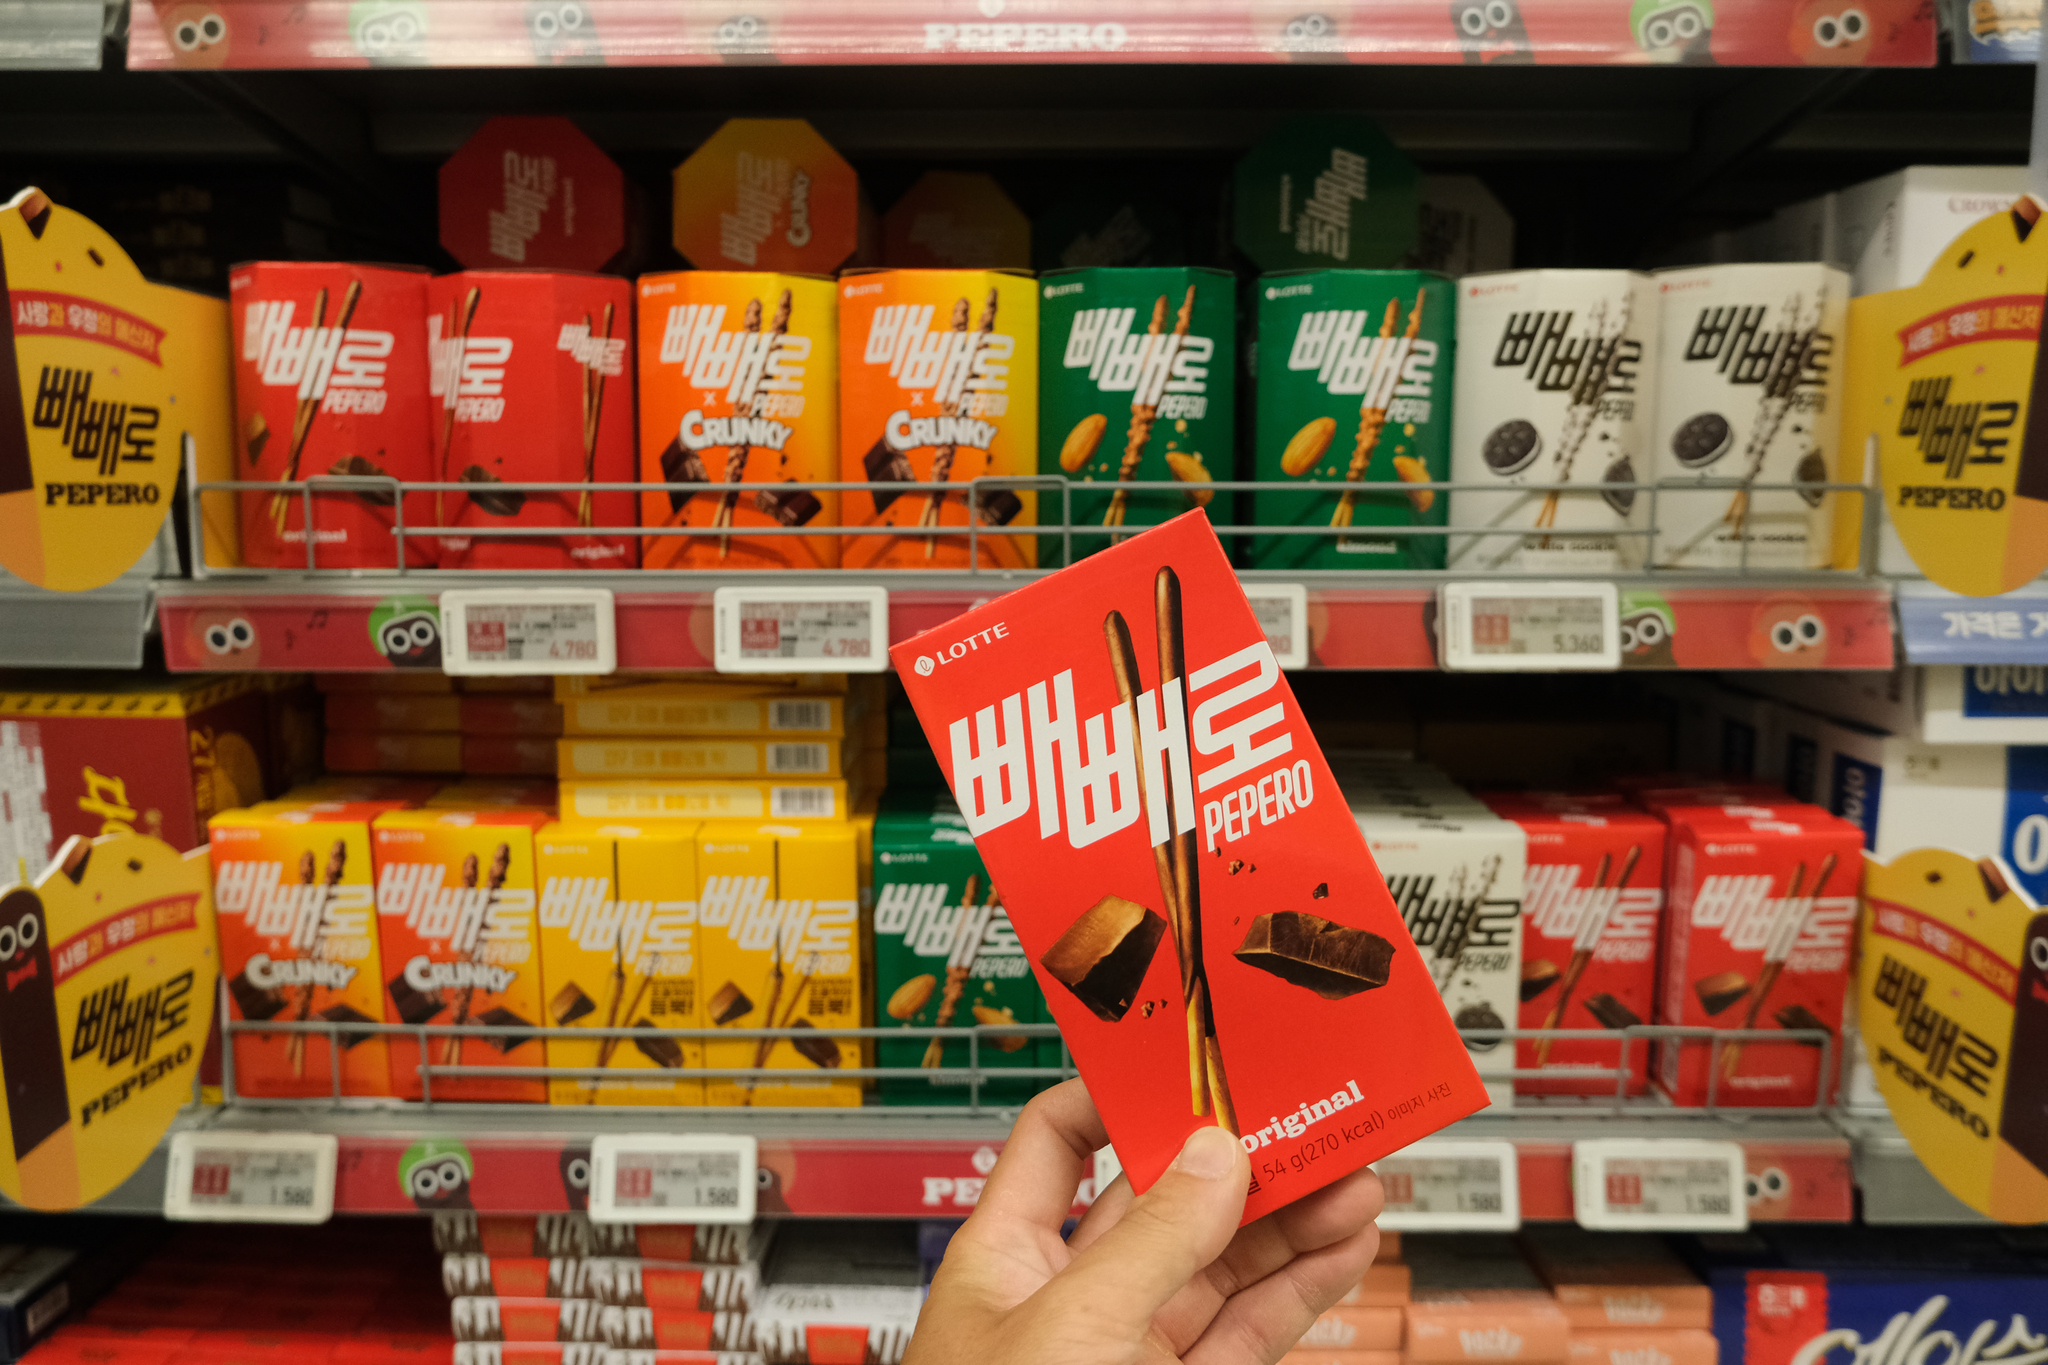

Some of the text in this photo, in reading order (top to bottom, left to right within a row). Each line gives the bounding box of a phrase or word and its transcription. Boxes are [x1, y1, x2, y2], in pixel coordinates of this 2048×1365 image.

[924, 22, 1128, 51] PEPERO
[243, 301, 395, 400] 빼빼로
[660, 304, 811, 402] 빼빼로
[864, 304, 1015, 403] 빼빼로
[1063, 307, 1214, 405] 빼빼로
[1288, 309, 1438, 410] 빼빼로
[1493, 311, 1642, 406] 빼빼로
[1684, 304, 1834, 398] 빼빼로
[33, 365, 161, 476] 빼빼로
[679, 410, 793, 451] CRUNKY
[885, 410, 998, 450] CRUNKY
[1898, 375, 2019, 480] 빼빼로
[45, 483, 160, 507] PEPERO
[1897, 485, 2007, 511] PEPERO
[549, 639, 597, 661] 4.780
[823, 638, 871, 659] 4.780
[936, 621, 1010, 665] LOTTE
[1941, 611, 2025, 640] 가격은
[949, 640, 1293, 850] 빼빼로
[1203, 759, 1315, 852] PEPERO
[215, 861, 374, 949] 빼빼로
[377, 862, 536, 952] 빼빼로
[540, 876, 698, 965] 빼빼로
[699, 875, 858, 963] 빼빼로
[874, 883, 1026, 968] 빼빼로
[1522, 864, 1663, 951] 빼빼로
[1691, 875, 1858, 963] 빼빼로
[245, 953, 357, 991] CRUNKY
[404, 955, 518, 993] CRUNKY
[71, 969, 195, 1069] 빼빼로
[1873, 954, 2000, 1098] 빼빼로
[81, 1042, 194, 1128] PEPERO
[1240, 1079, 1365, 1153] original
[1877, 1045, 1991, 1140] PEPERO
[1263, 1081, 1453, 1182] 54 g(270 kcal) 이미지 사진
